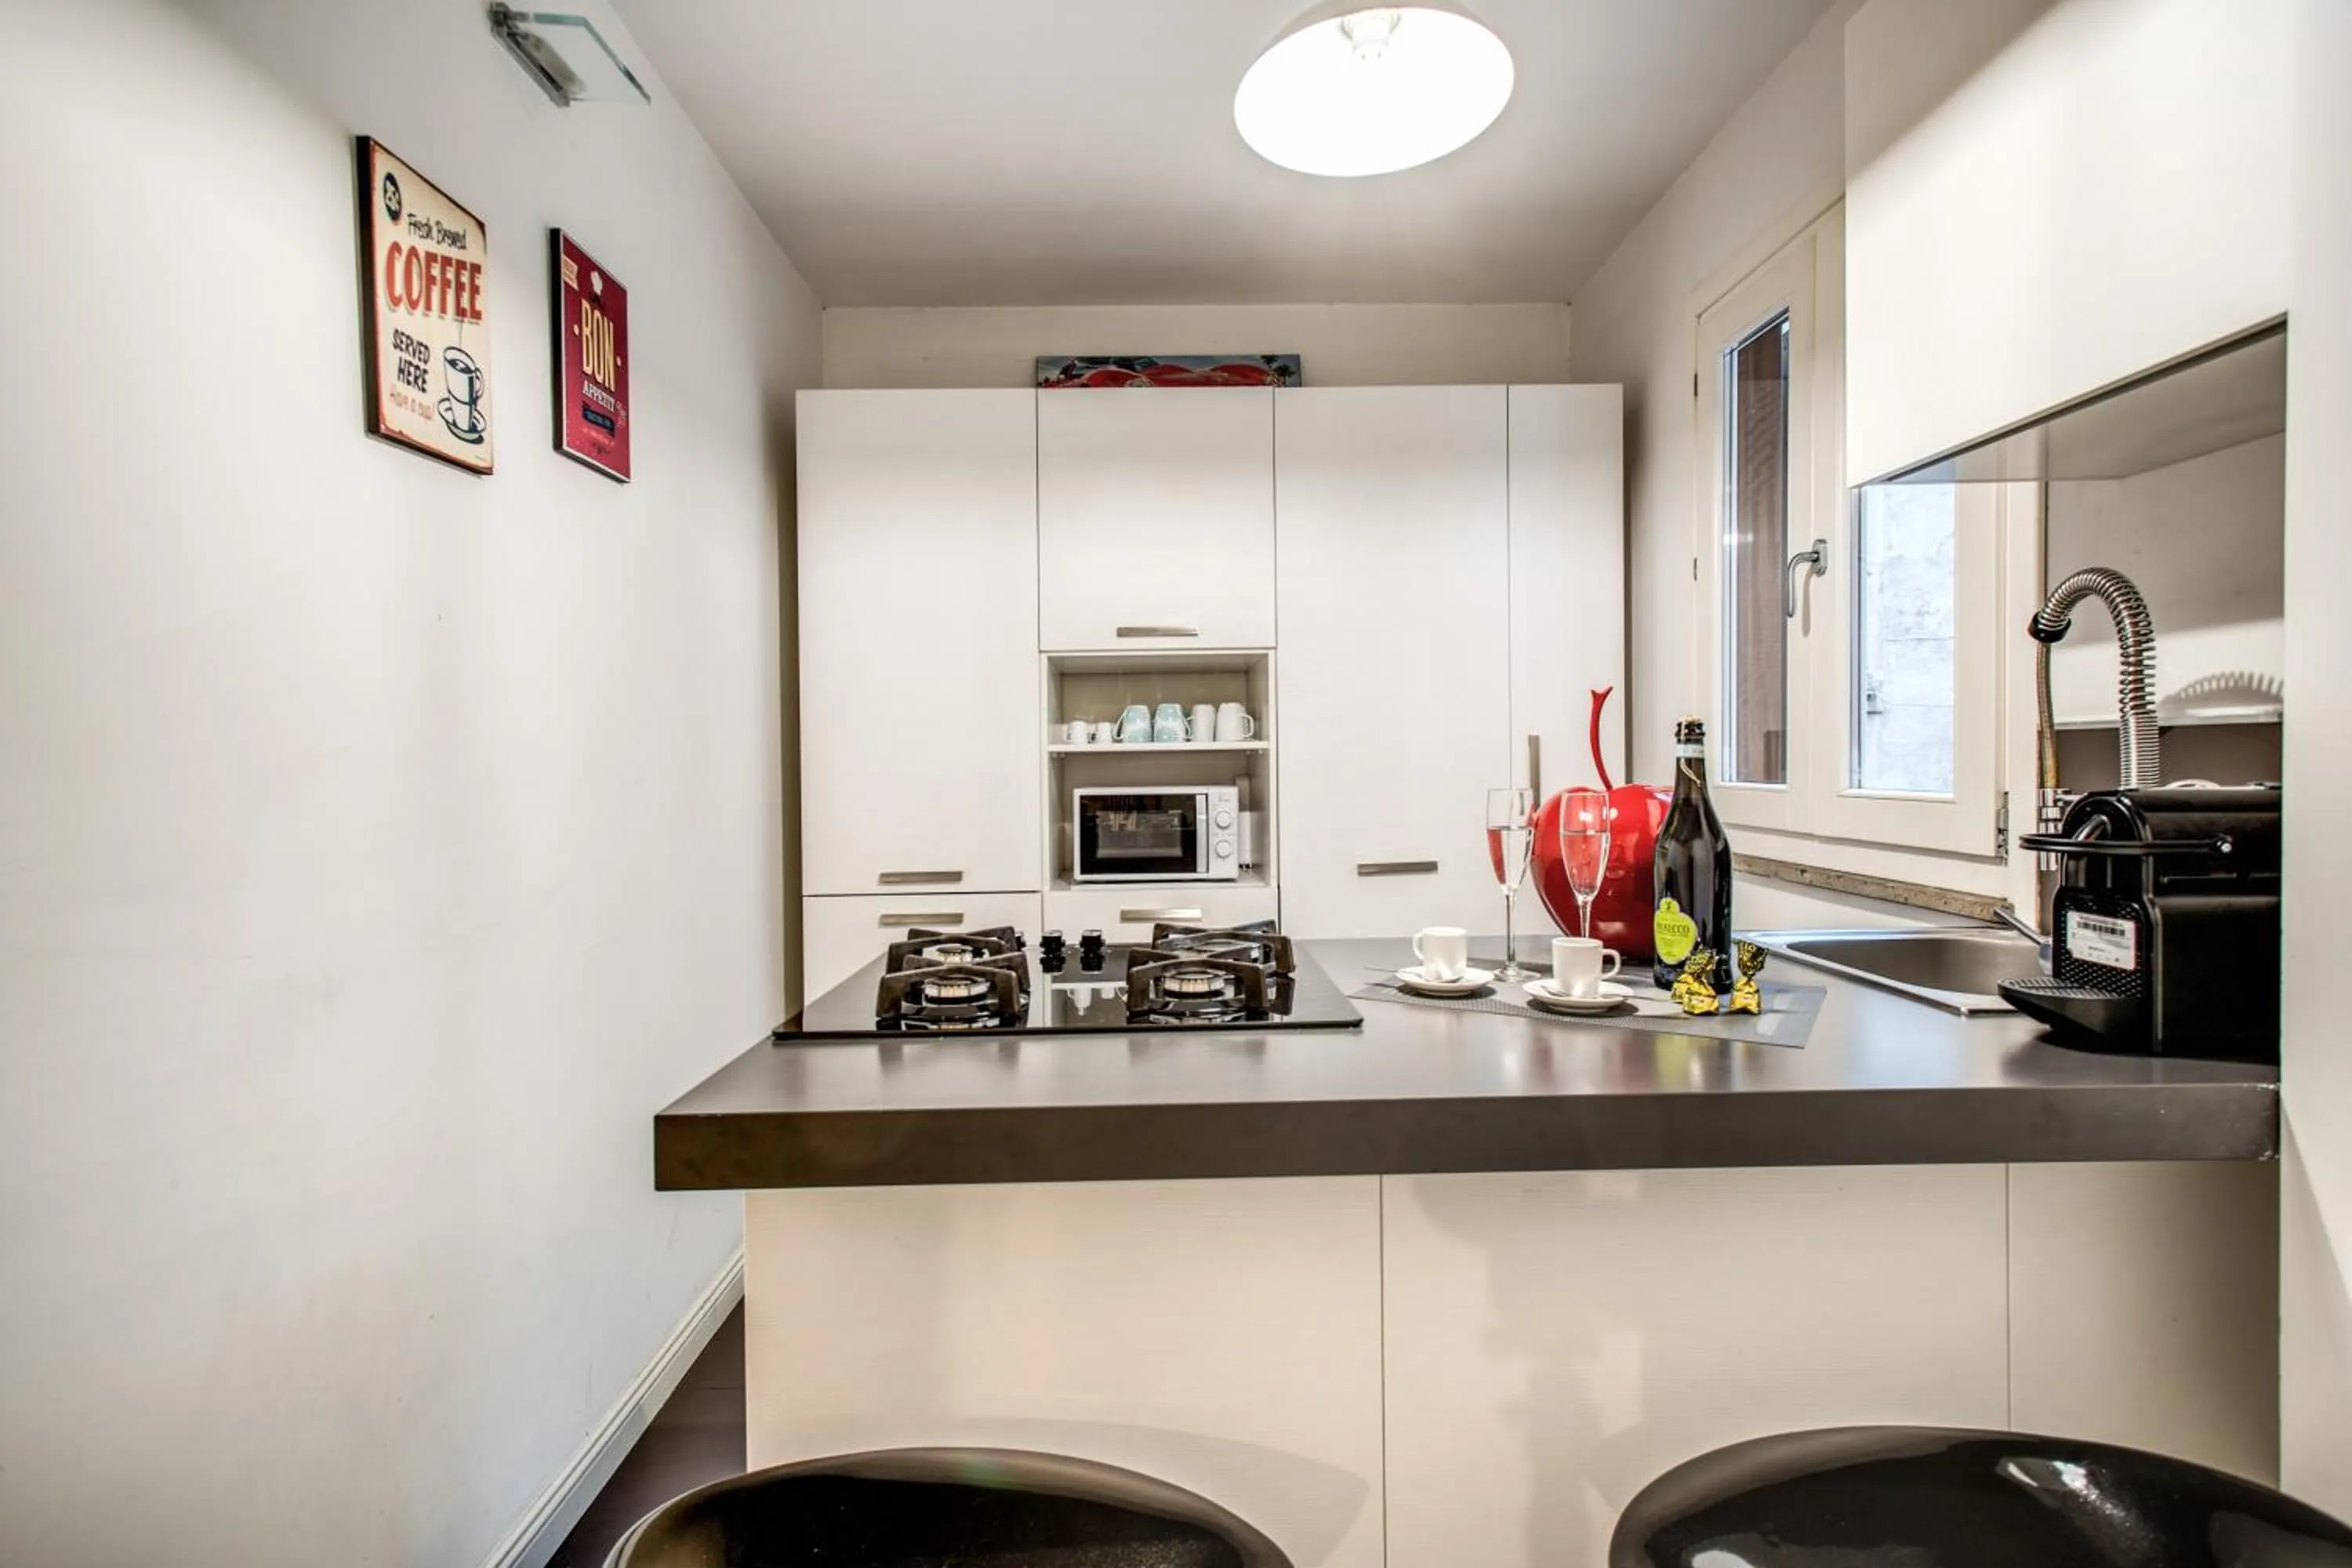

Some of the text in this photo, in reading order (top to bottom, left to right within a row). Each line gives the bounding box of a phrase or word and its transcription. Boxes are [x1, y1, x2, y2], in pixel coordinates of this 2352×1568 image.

[407, 212, 434, 240] Fresh
[386, 241, 483, 321] COFFEE
[393, 328, 430, 365] SERVED
[582, 299, 615, 393] BON
[397, 356, 428, 394] HERE
